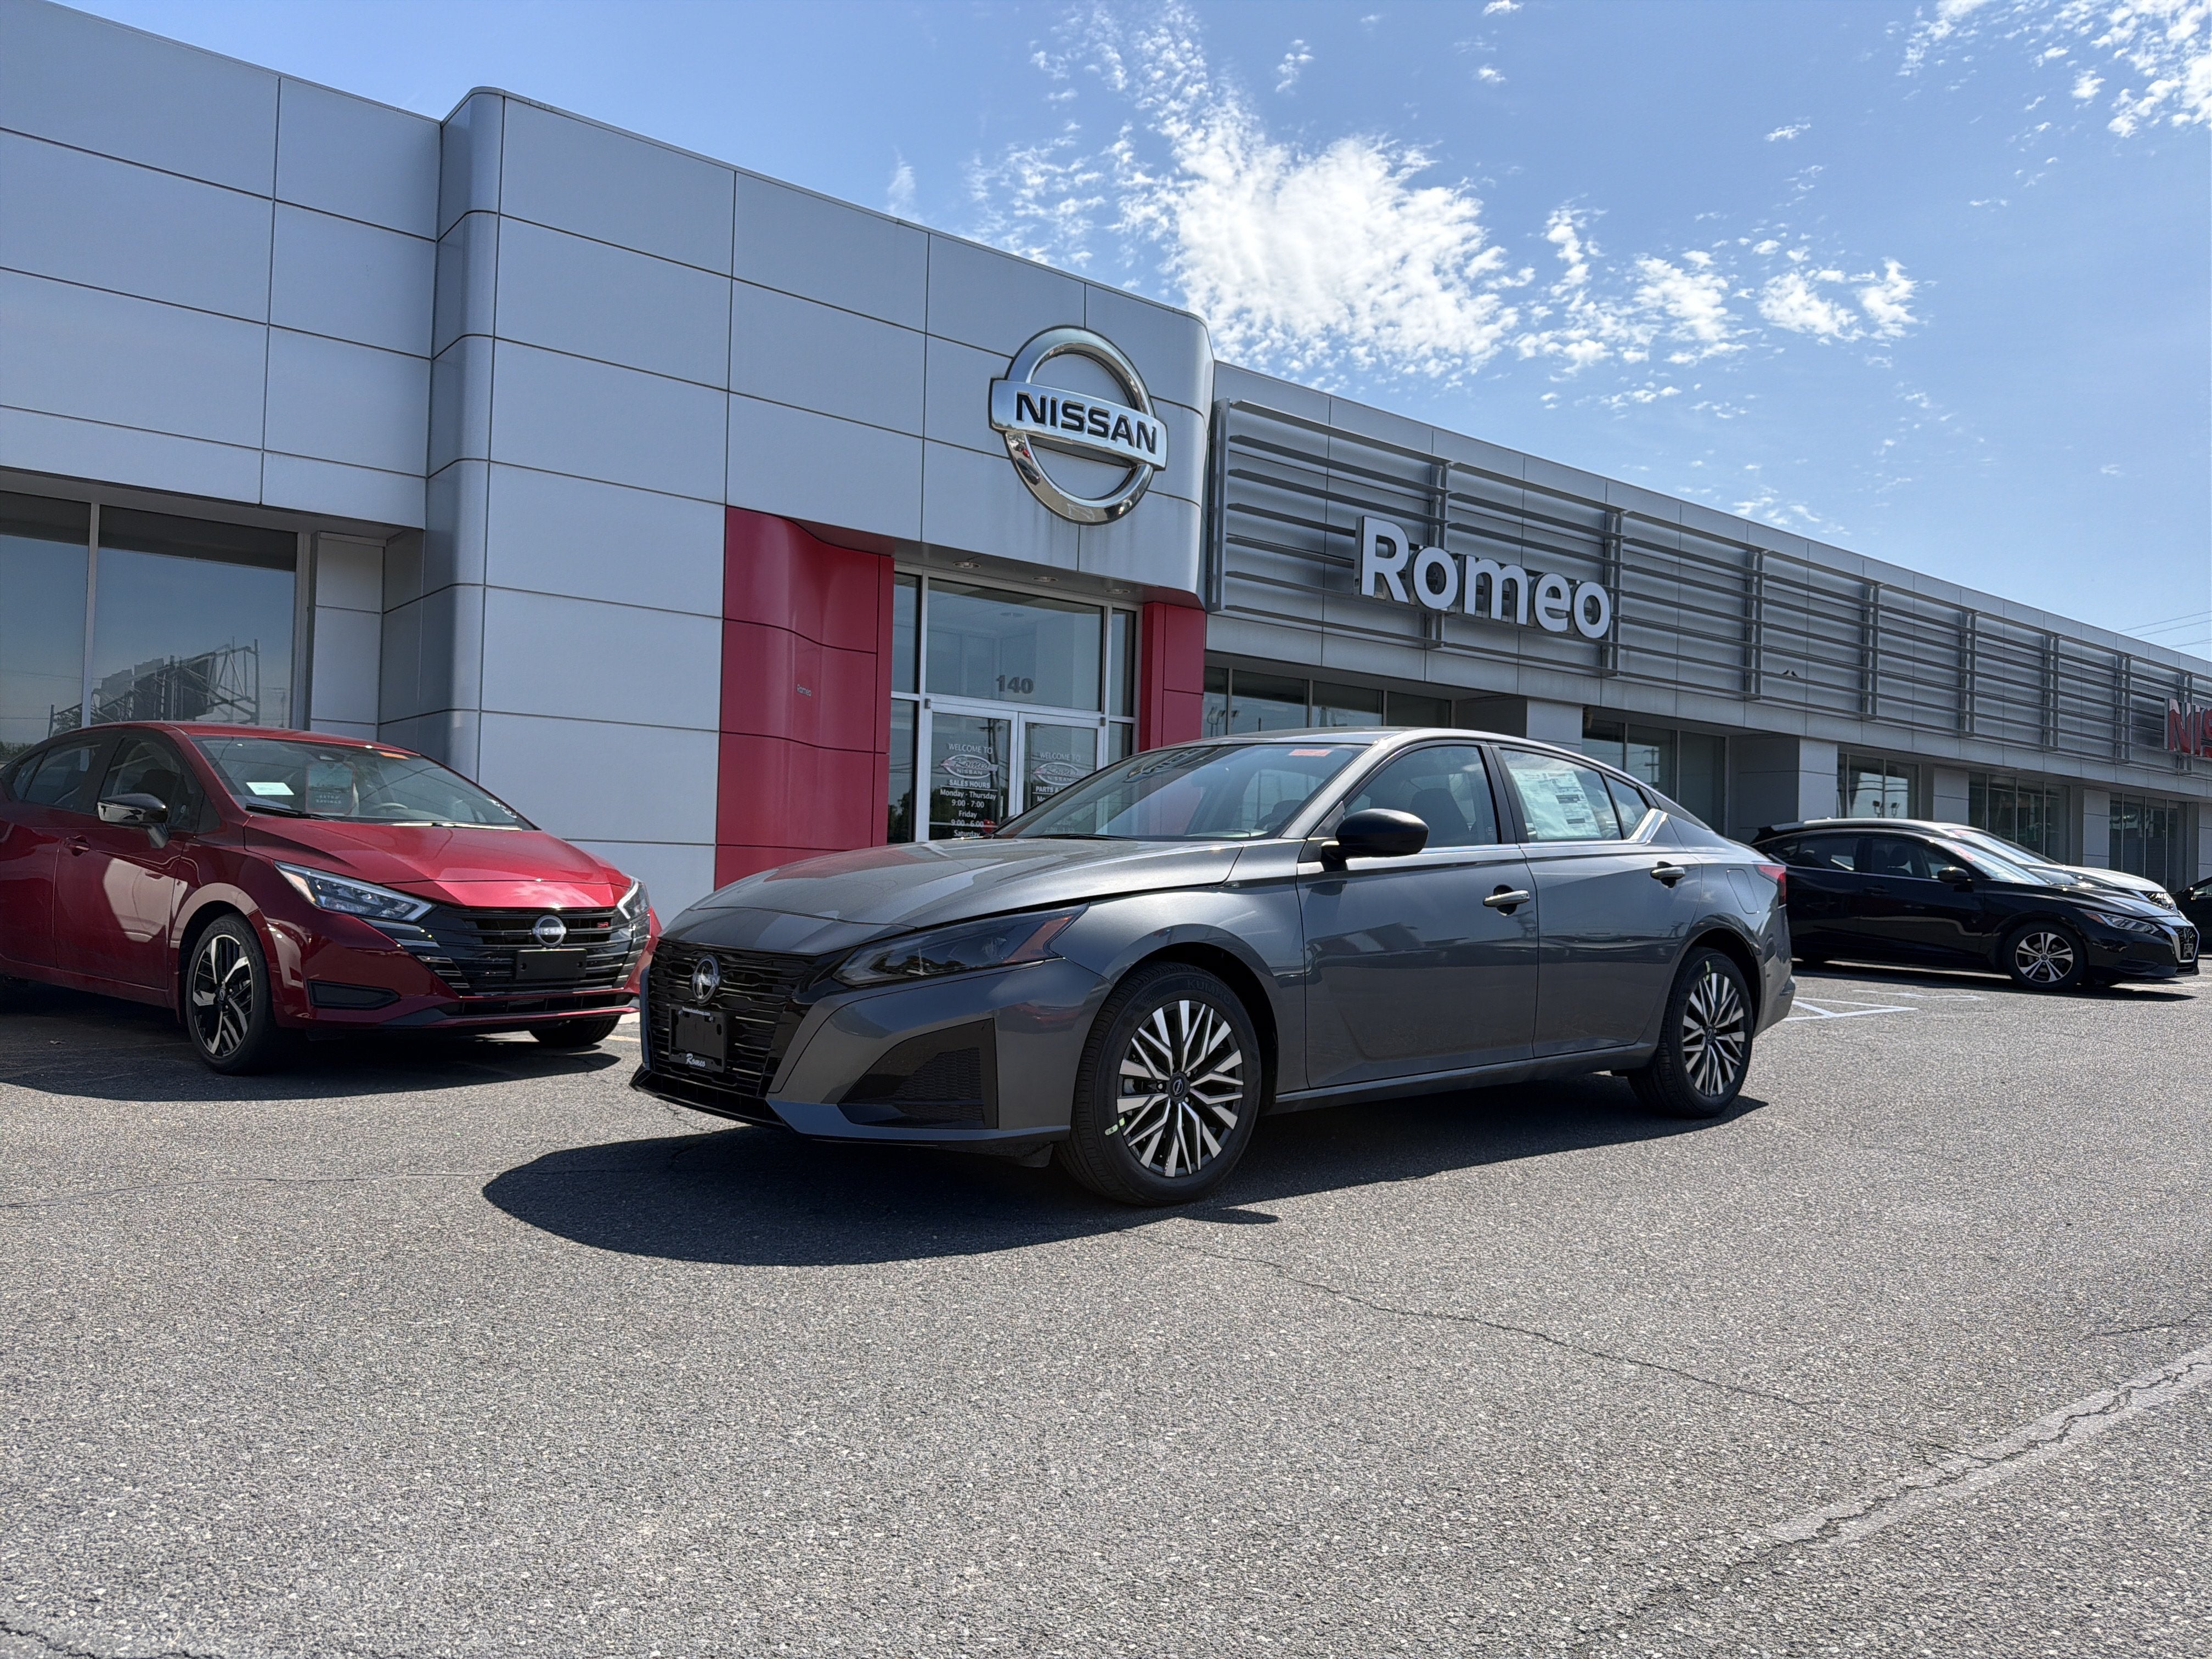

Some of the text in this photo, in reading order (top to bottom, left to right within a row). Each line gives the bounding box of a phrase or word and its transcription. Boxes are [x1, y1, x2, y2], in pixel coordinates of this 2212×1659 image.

[1016, 392, 1156, 455] NISSAN
[1356, 515, 1611, 639] Romeo
[996, 675, 1034, 694] 140
[949, 743, 981, 753] WELCOME
[1040, 752, 1070, 761] WELCOME
[940, 789, 964, 798] Monday
[969, 791, 996, 800] Thursday
[958, 810, 978, 819] Friday
[686, 1053, 706, 1068] Romeo
